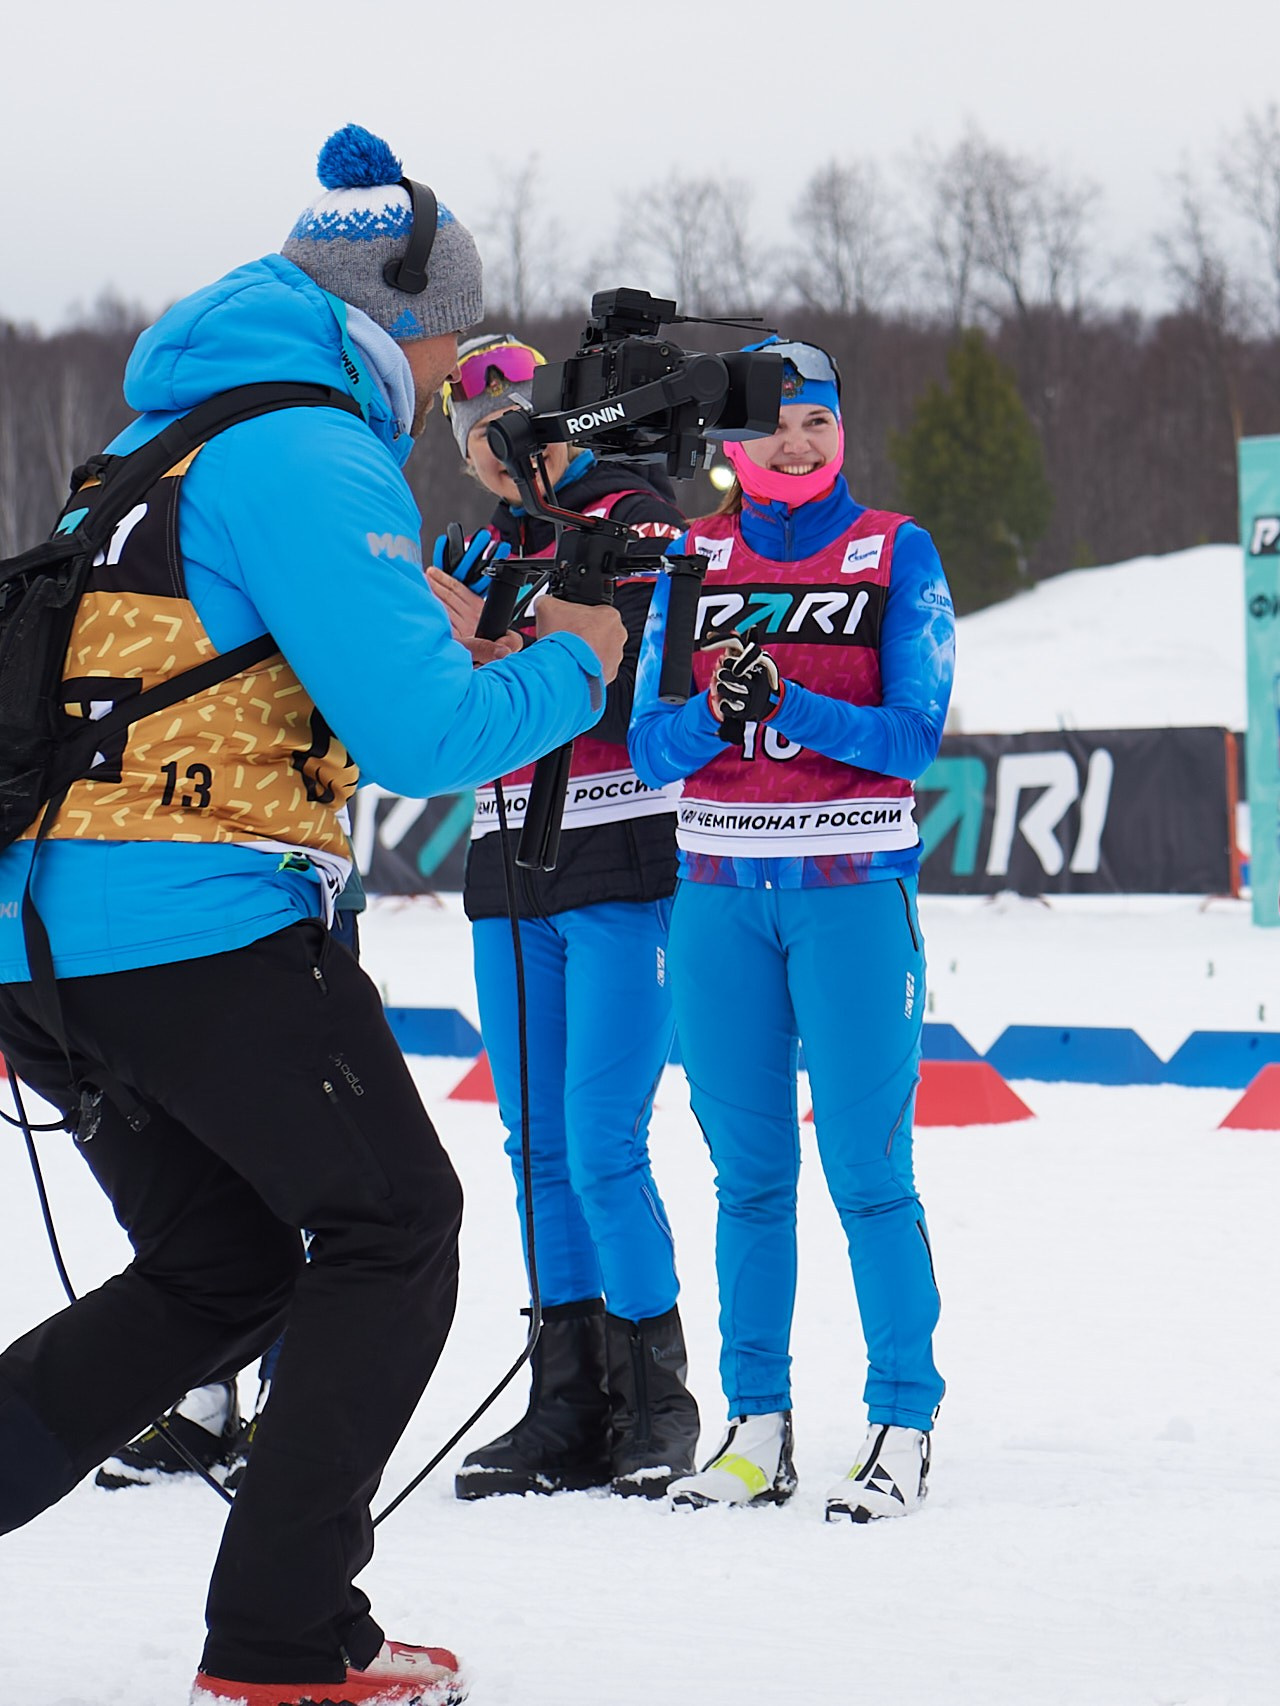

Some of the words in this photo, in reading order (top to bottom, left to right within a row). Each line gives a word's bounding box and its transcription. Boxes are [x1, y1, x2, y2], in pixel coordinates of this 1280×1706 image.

[566, 403, 626, 434] RONIN
[694, 590, 869, 641] PARI
[160, 761, 213, 808] 13
[574, 780, 662, 803] РОССИ
[698, 814, 811, 831] ЧЕМПИОНАТ
[815, 809, 902, 828] РОССИИ
[917, 748, 1114, 876] ARI
